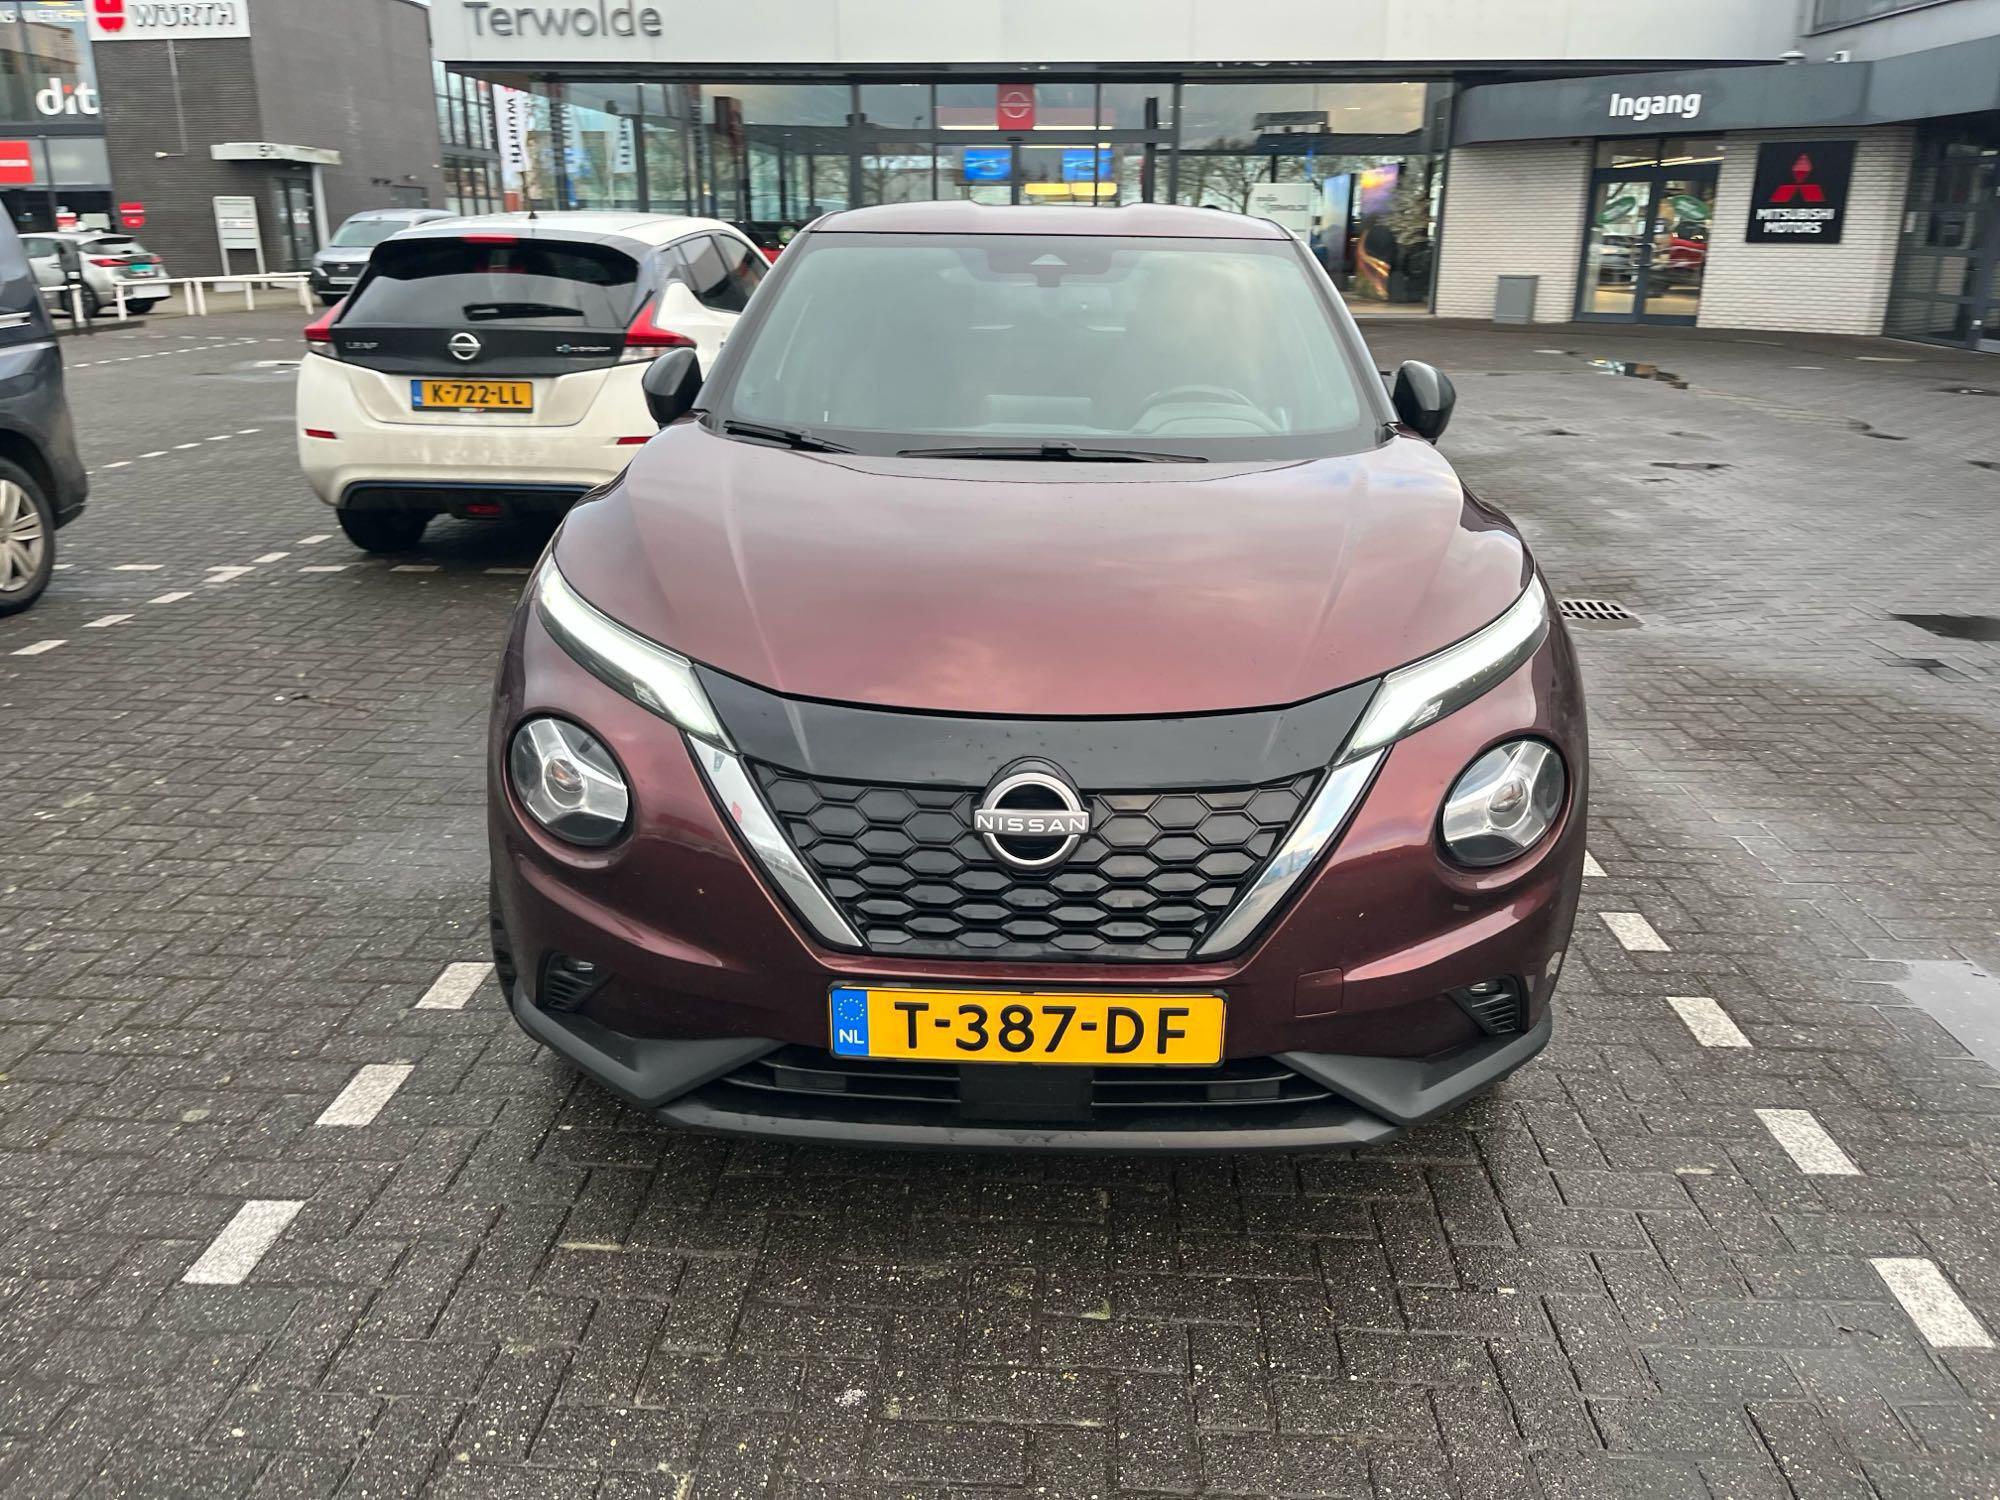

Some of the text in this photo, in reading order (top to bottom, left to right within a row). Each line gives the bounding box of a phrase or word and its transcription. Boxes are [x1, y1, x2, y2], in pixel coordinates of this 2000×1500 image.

[463, 0, 663, 37] Terwolde
[36, 77, 99, 115] dit
[1609, 93, 1702, 121] Ingang
[1756, 208, 1835, 220] MITSUBISHI
[1763, 221, 1822, 233] MOTORS
[432, 384, 523, 405] K-722-LL
[977, 814, 1086, 833] NISSAN
[839, 1002, 1190, 1054] NL T-387-DF
